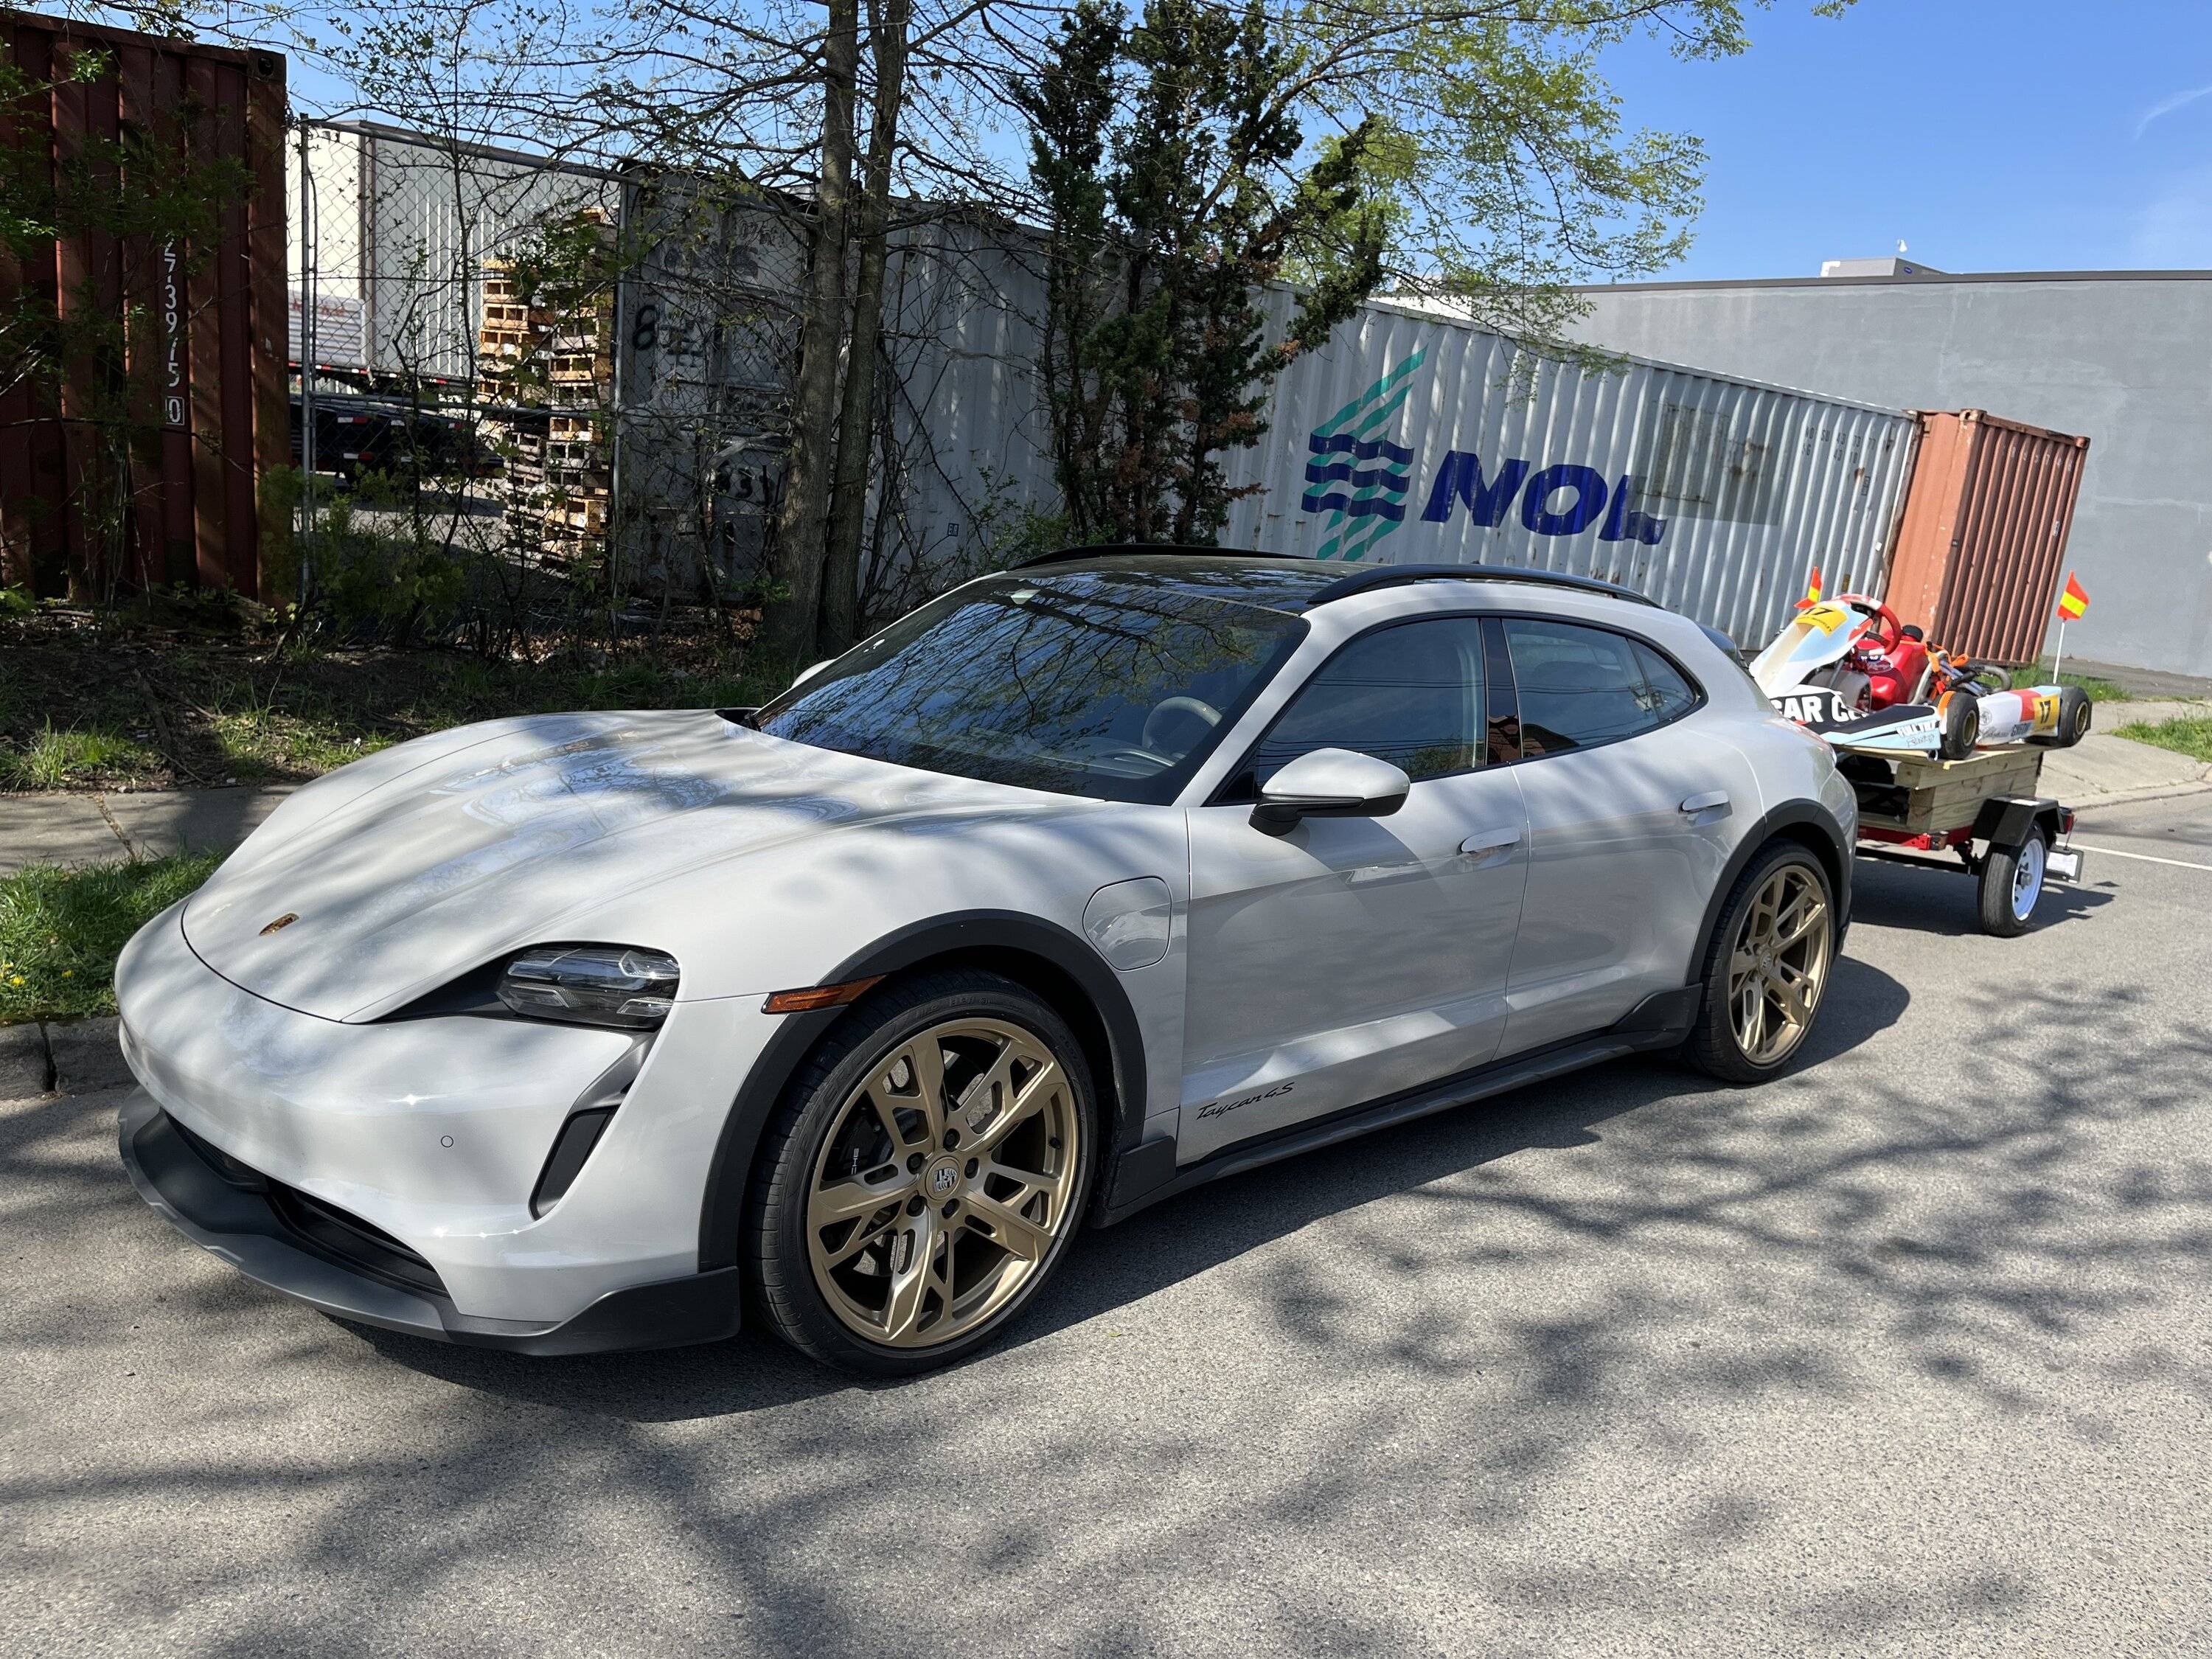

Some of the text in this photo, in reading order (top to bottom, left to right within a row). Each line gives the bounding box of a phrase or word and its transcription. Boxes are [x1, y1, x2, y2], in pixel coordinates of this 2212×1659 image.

[1419, 450, 1669, 545] NOL
[2039, 700, 2051, 724] 17
[1197, 1082, 1295, 1120] Taycan 4S
